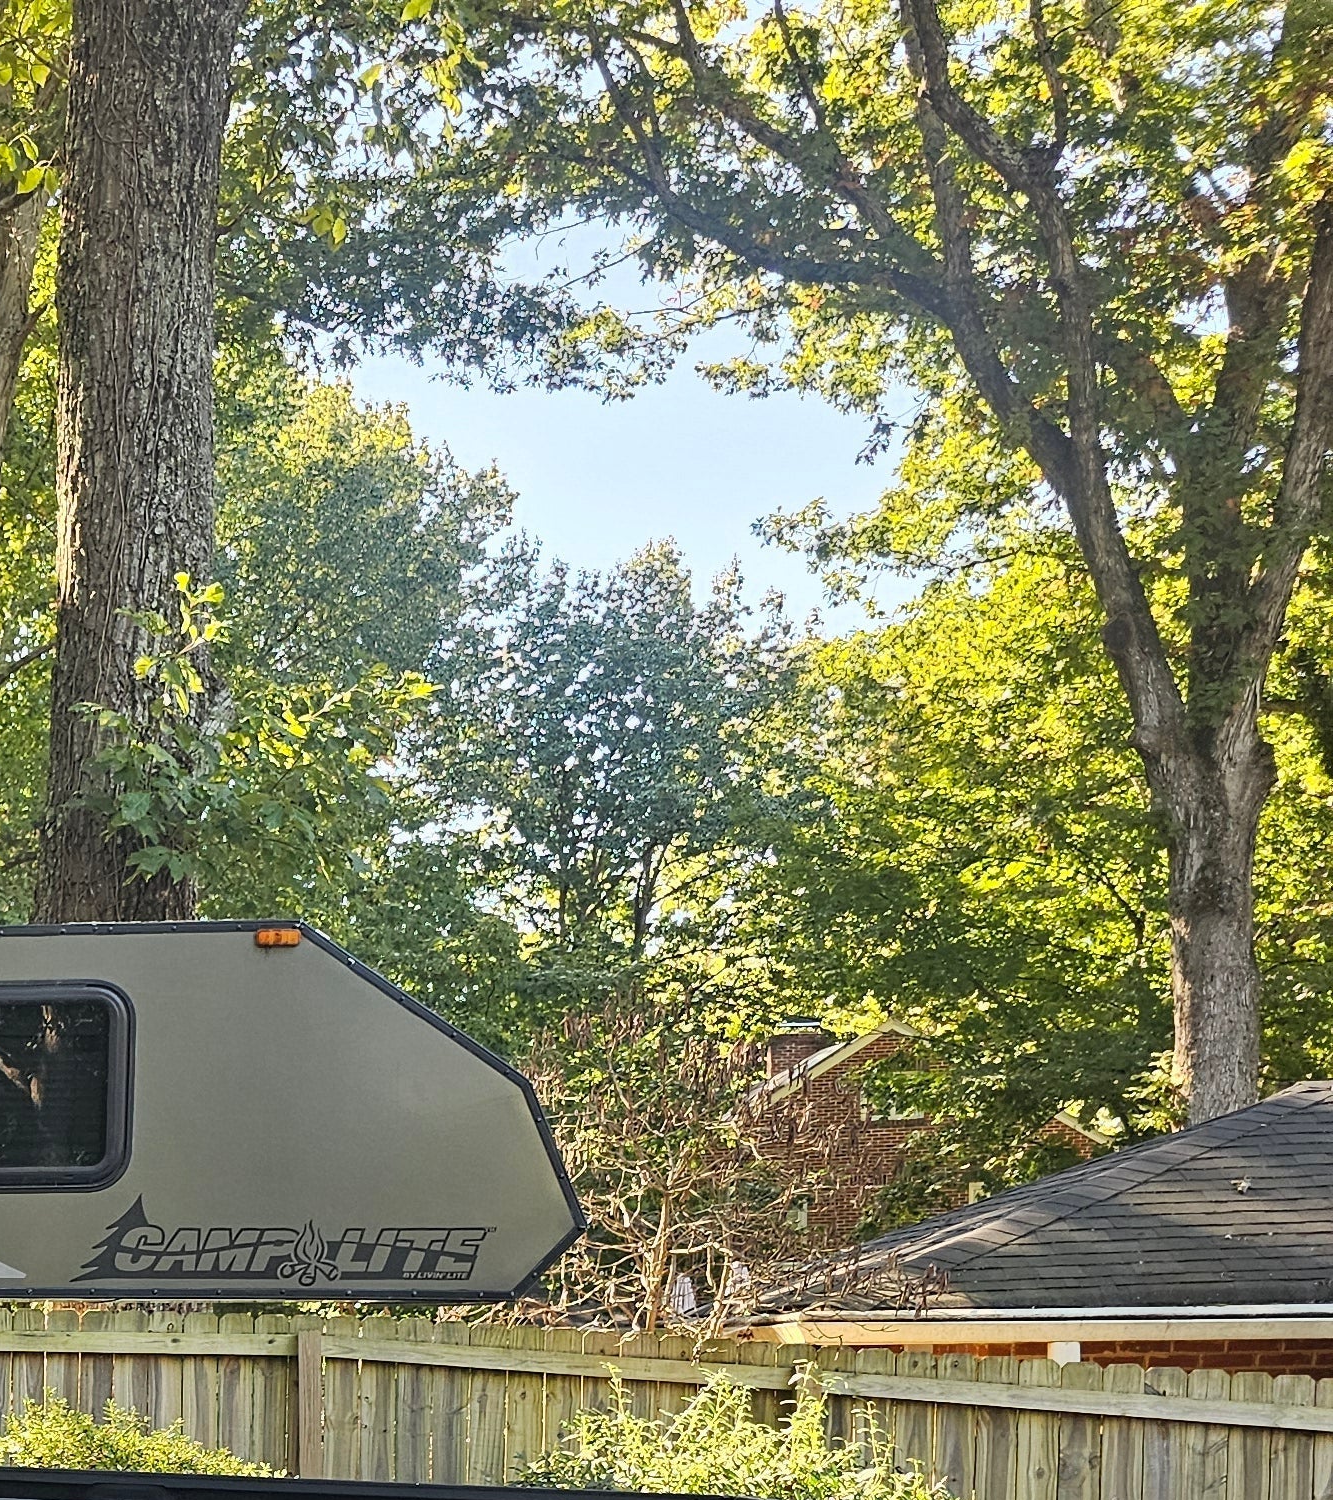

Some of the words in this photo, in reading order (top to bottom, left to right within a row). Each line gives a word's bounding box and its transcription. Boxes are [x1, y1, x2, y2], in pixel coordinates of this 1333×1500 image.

[113, 1224, 301, 1273] CAMP
[334, 1227, 487, 1274] LITE
[402, 1271, 417, 1280] BY
[446, 1272, 469, 1280] LITE
